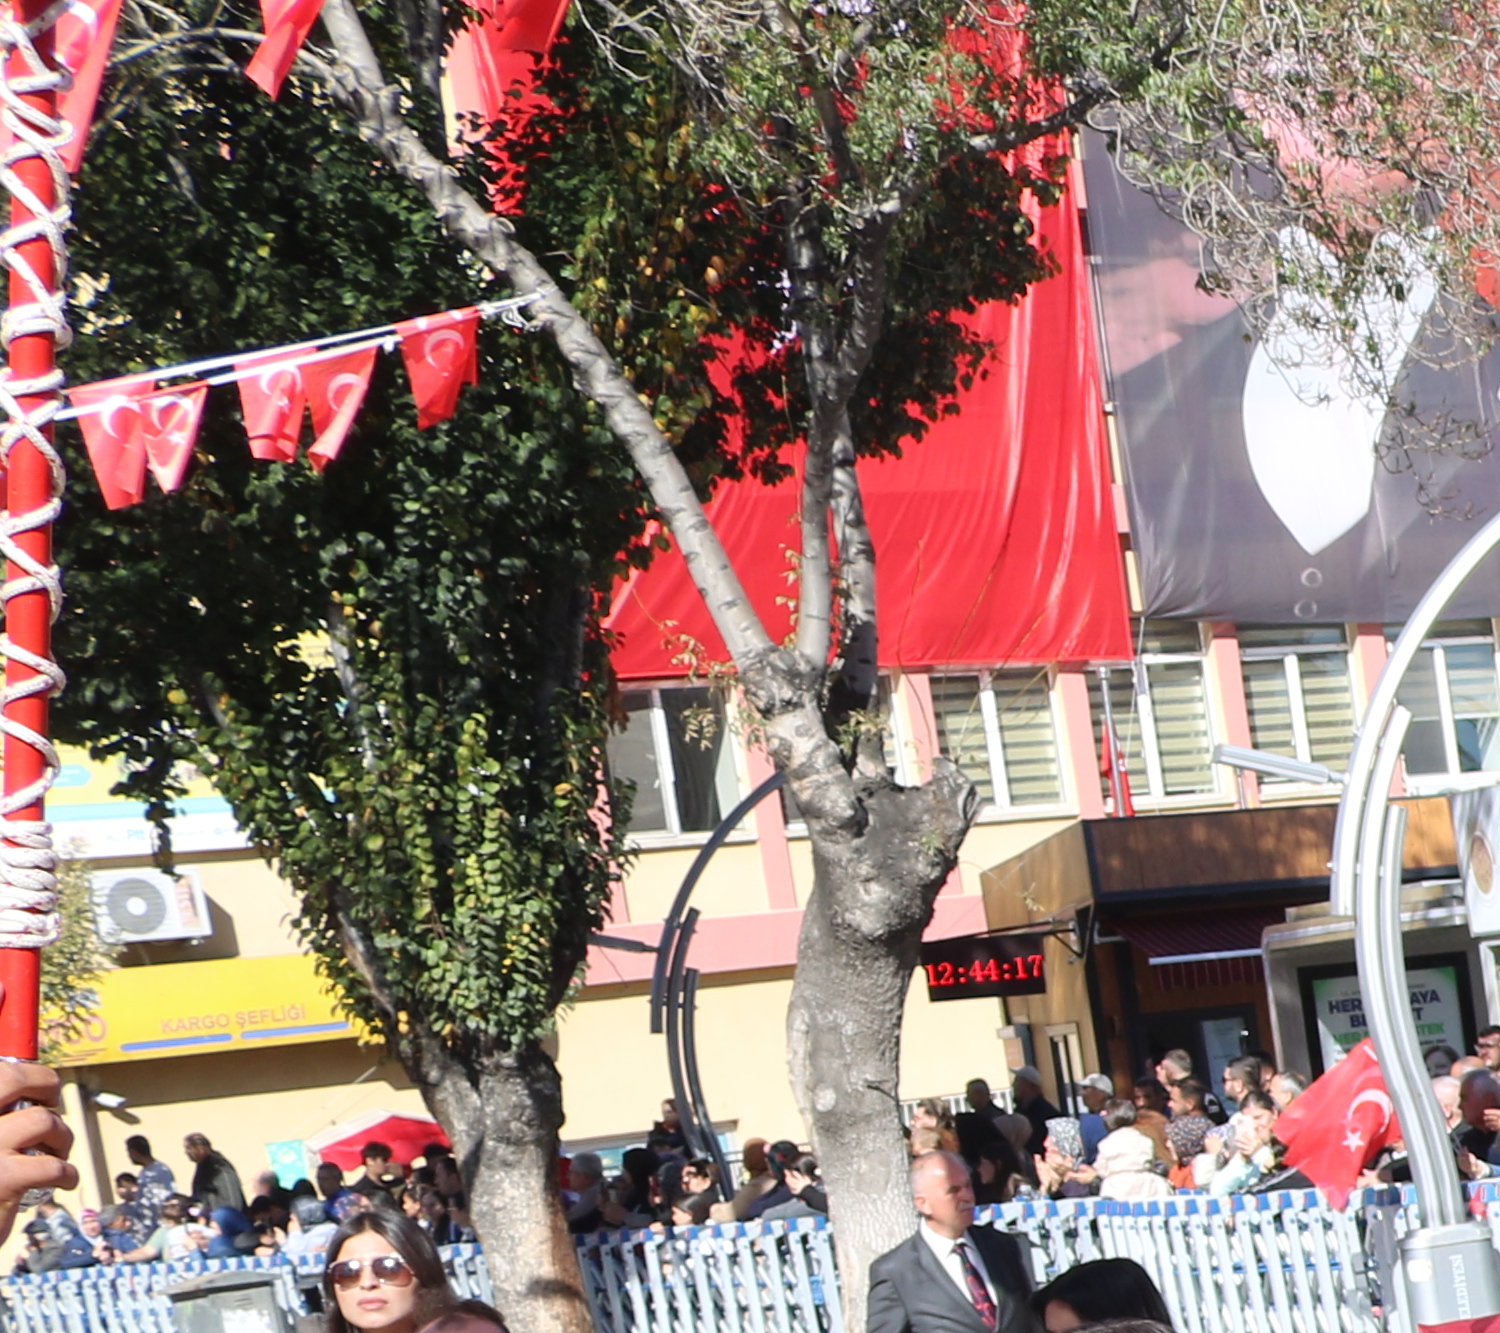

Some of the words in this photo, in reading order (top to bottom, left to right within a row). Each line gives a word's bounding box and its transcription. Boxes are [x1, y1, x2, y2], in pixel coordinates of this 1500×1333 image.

[925, 954, 1043, 987] 12:44:17
[161, 1013, 230, 1034] KARGO
[235, 1004, 306, 1029] ŞEFLİĞİ
[1448, 1254, 1472, 1320] ELEDİYESİ
